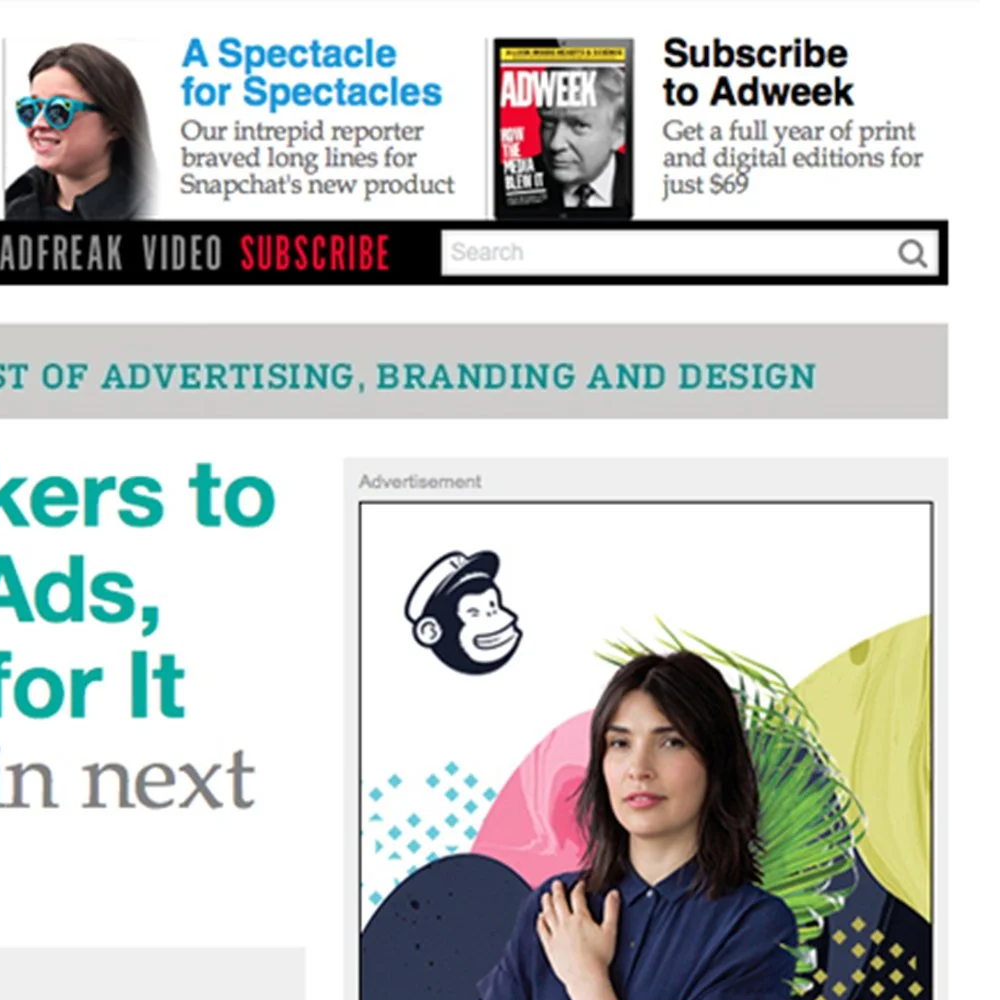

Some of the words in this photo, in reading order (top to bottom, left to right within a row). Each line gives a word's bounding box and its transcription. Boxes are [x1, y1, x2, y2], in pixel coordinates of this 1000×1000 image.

[182, 37, 209, 68] A
[218, 37, 397, 73] Spectacle
[664, 37, 848, 68] Subscribe
[181, 76, 232, 106] for
[244, 74, 442, 114] Spectacles
[500, 70, 598, 107] ADWEEK
[662, 78, 699, 106] to
[710, 76, 854, 106] Adweek
[180, 119, 228, 141] Our
[234, 119, 325, 144] intrepid
[331, 123, 424, 144] reporter
[663, 119, 704, 141] Get
[710, 125, 723, 141] a
[729, 119, 768, 141] full
[773, 125, 825, 144] year
[829, 119, 853, 141] of
[859, 120, 916, 144] print
[181, 146, 261, 168] braved
[267, 145, 319, 171] long
[324, 145, 378, 168] lines
[384, 146, 417, 168] for
[663, 146, 707, 176] and
[712, 145, 787, 176] digital
[792, 145, 885, 168] editions
[890, 146, 924, 168] for
[180, 173, 302, 201] Snapchat's
[304, 171, 358, 194] new
[364, 173, 455, 202] product
[662, 174, 704, 202] just
[709, 174, 749, 195] $69
[0, 235, 122, 270] ADFREAK
[143, 235, 221, 270] VIDEO
[240, 234, 389, 271] SUBSCRIBE
[452, 243, 522, 260] Search
[42, 363, 88, 390] OF
[101, 363, 364, 392] ADVERTISING,
[377, 363, 575, 390] BRANDING
[587, 363, 665, 389] AND
[679, 363, 816, 389] DESIGN
[188, 463, 275, 528] to
[358, 474, 481, 489] Advertisement
[131, 650, 185, 719] It
[82, 750, 255, 809] next
